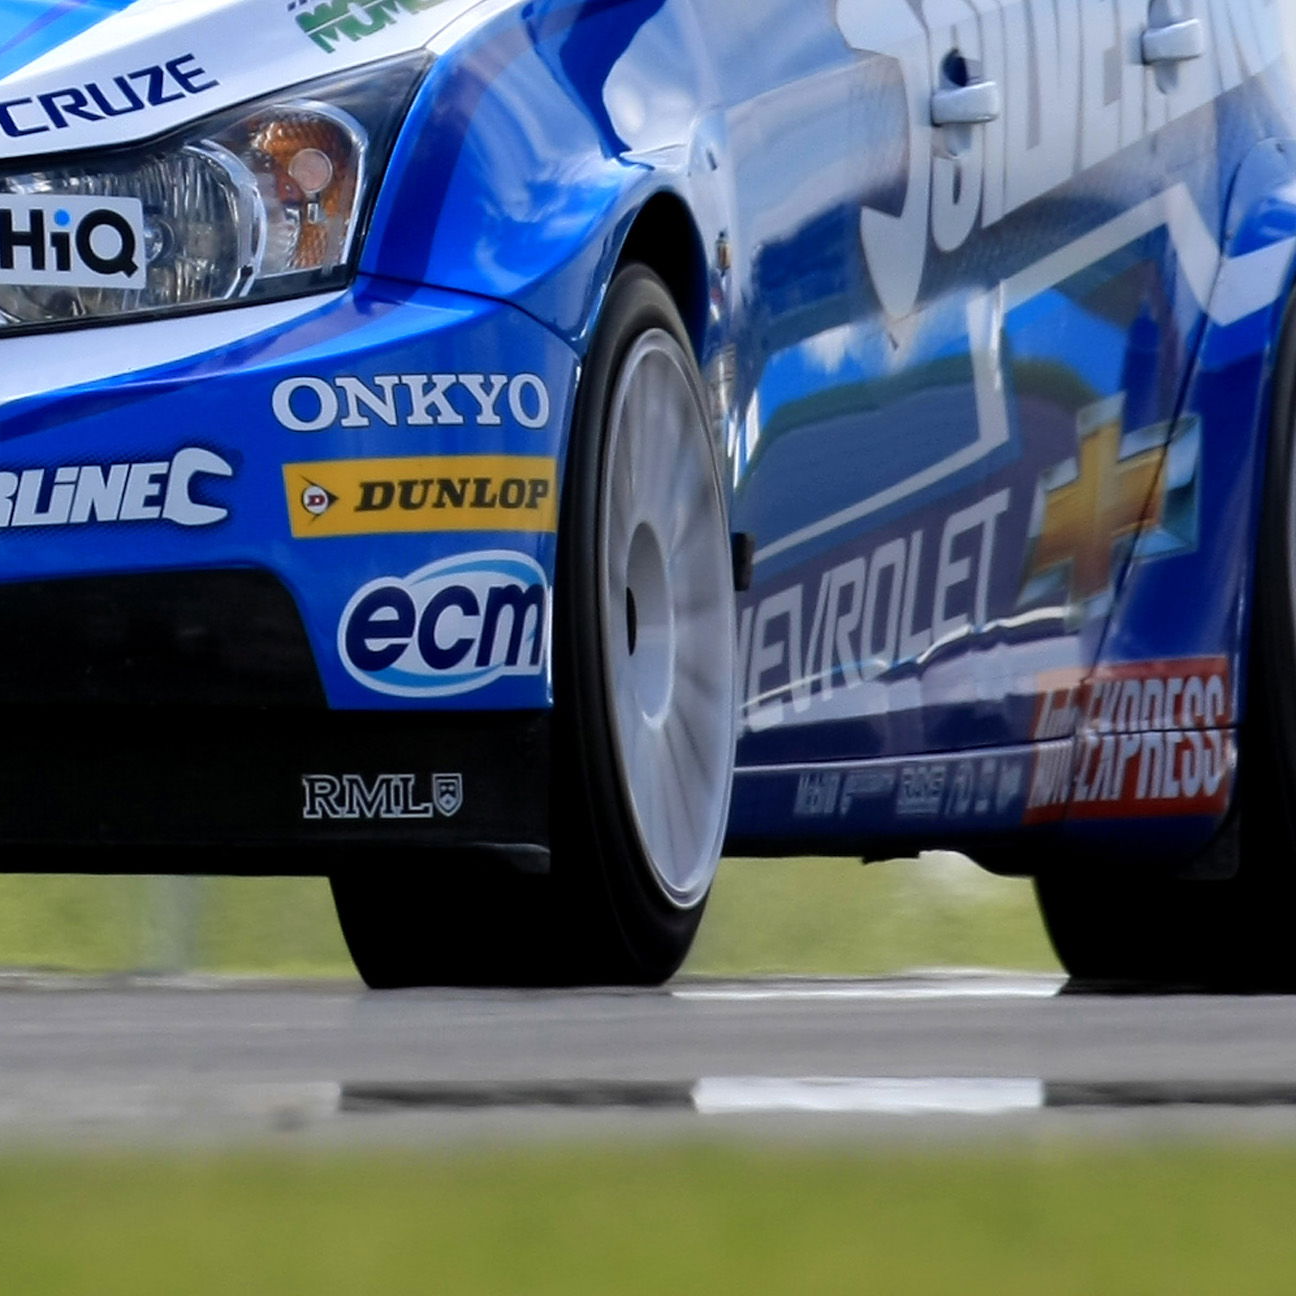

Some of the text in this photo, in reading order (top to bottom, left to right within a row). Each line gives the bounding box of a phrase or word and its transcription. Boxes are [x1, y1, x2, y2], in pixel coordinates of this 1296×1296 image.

[271, 373, 550, 431] ONKYO
[354, 477, 550, 513] DUNLOP
[345, 583, 545, 672] ecm
[303, 774, 433, 819] RML
